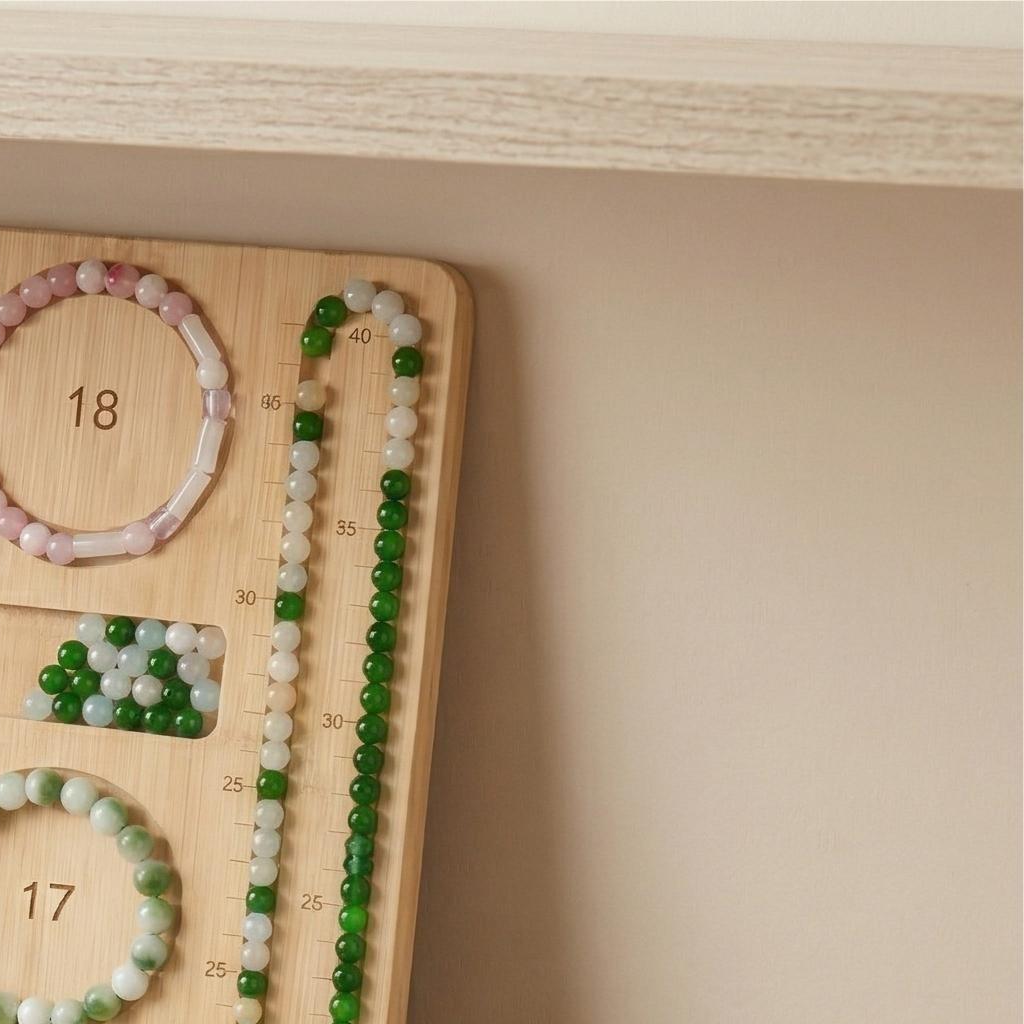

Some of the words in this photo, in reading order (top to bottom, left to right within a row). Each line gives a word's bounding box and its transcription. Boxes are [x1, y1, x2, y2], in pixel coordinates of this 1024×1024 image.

[349, 328, 372, 344] 40
[67, 385, 119, 431] 18
[235, 589, 256, 606] 30
[322, 713, 343, 730] 30
[222, 776, 243, 793] 25
[23, 881, 75, 922] 17
[301, 894, 323, 911] 25
[205, 960, 226, 978] 25
